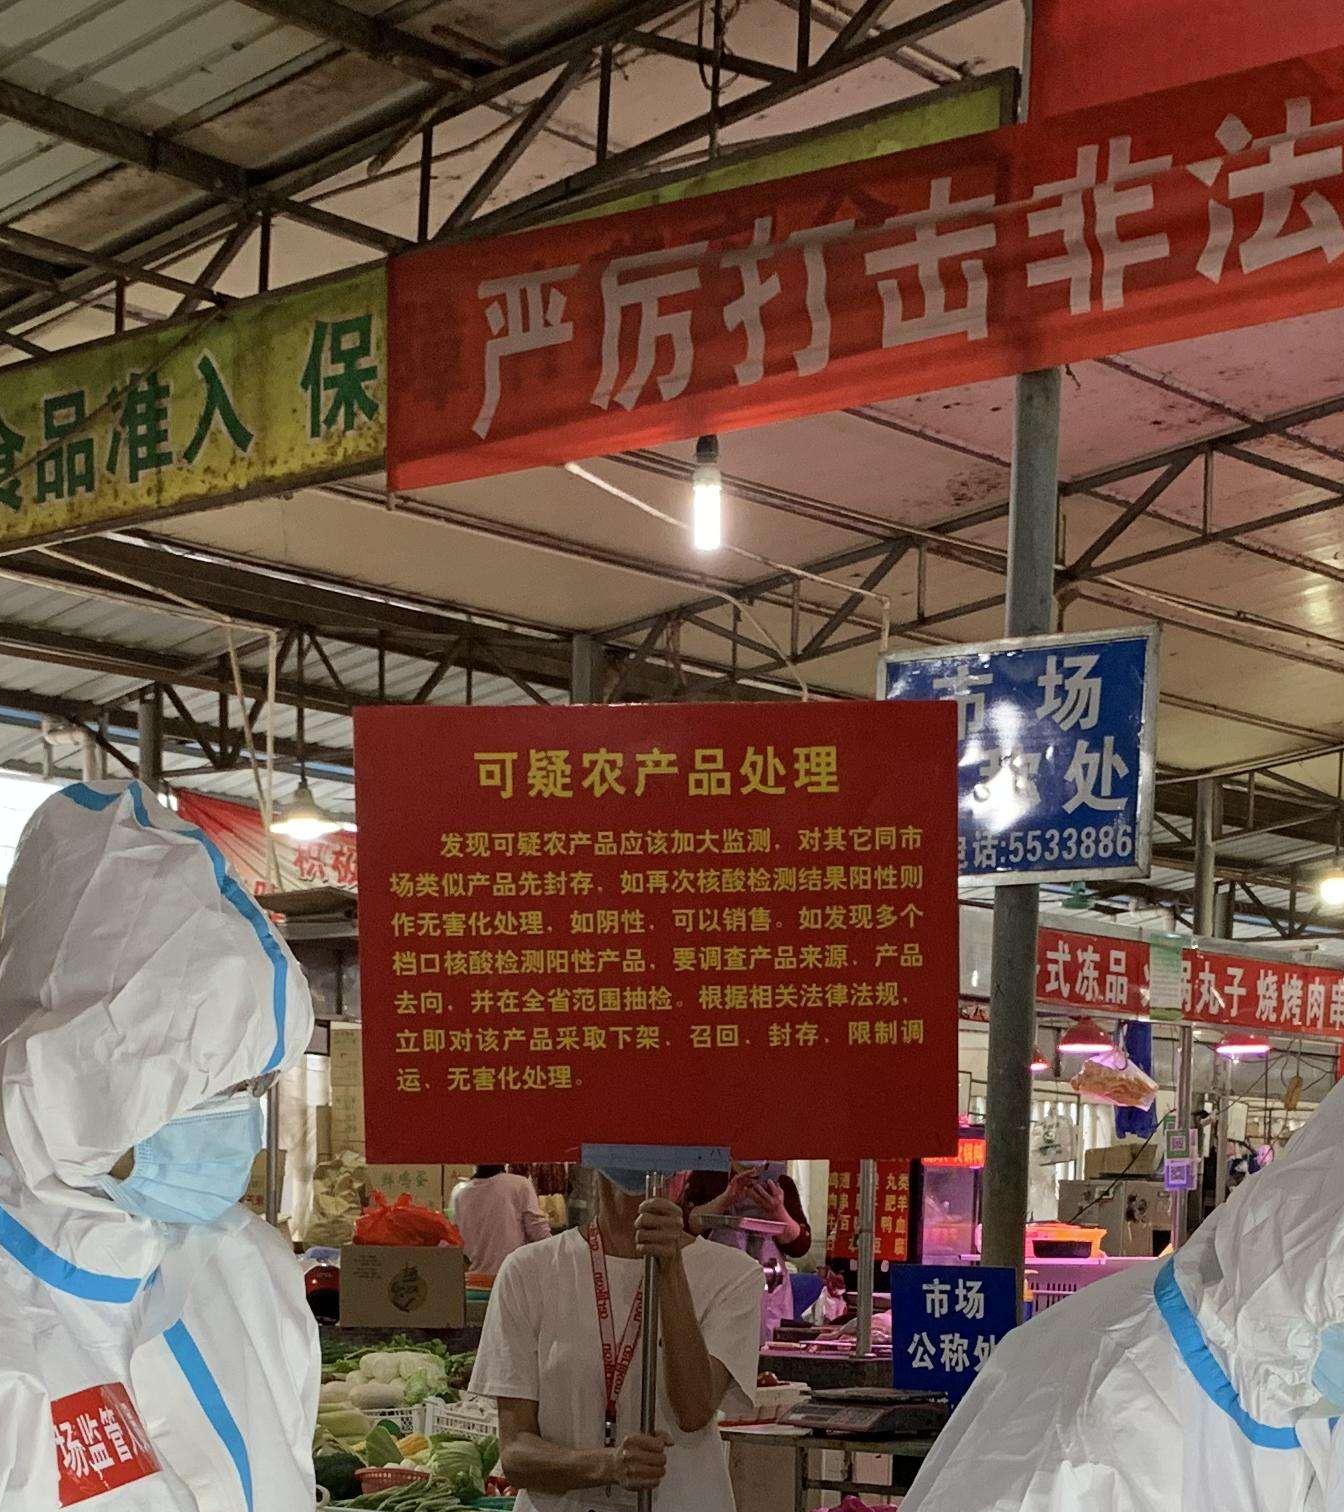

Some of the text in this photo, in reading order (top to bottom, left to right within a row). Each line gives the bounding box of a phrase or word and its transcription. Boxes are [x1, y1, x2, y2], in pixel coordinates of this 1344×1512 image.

[932, 654, 1102, 739] 市场
[474, 745, 839, 799] 可疑农产品处理
[1037, 940, 1128, 1005] 式冻品
[397, 1065, 584, 1093] 运、无害化处理。
[922, 1278, 985, 1319] 市场
